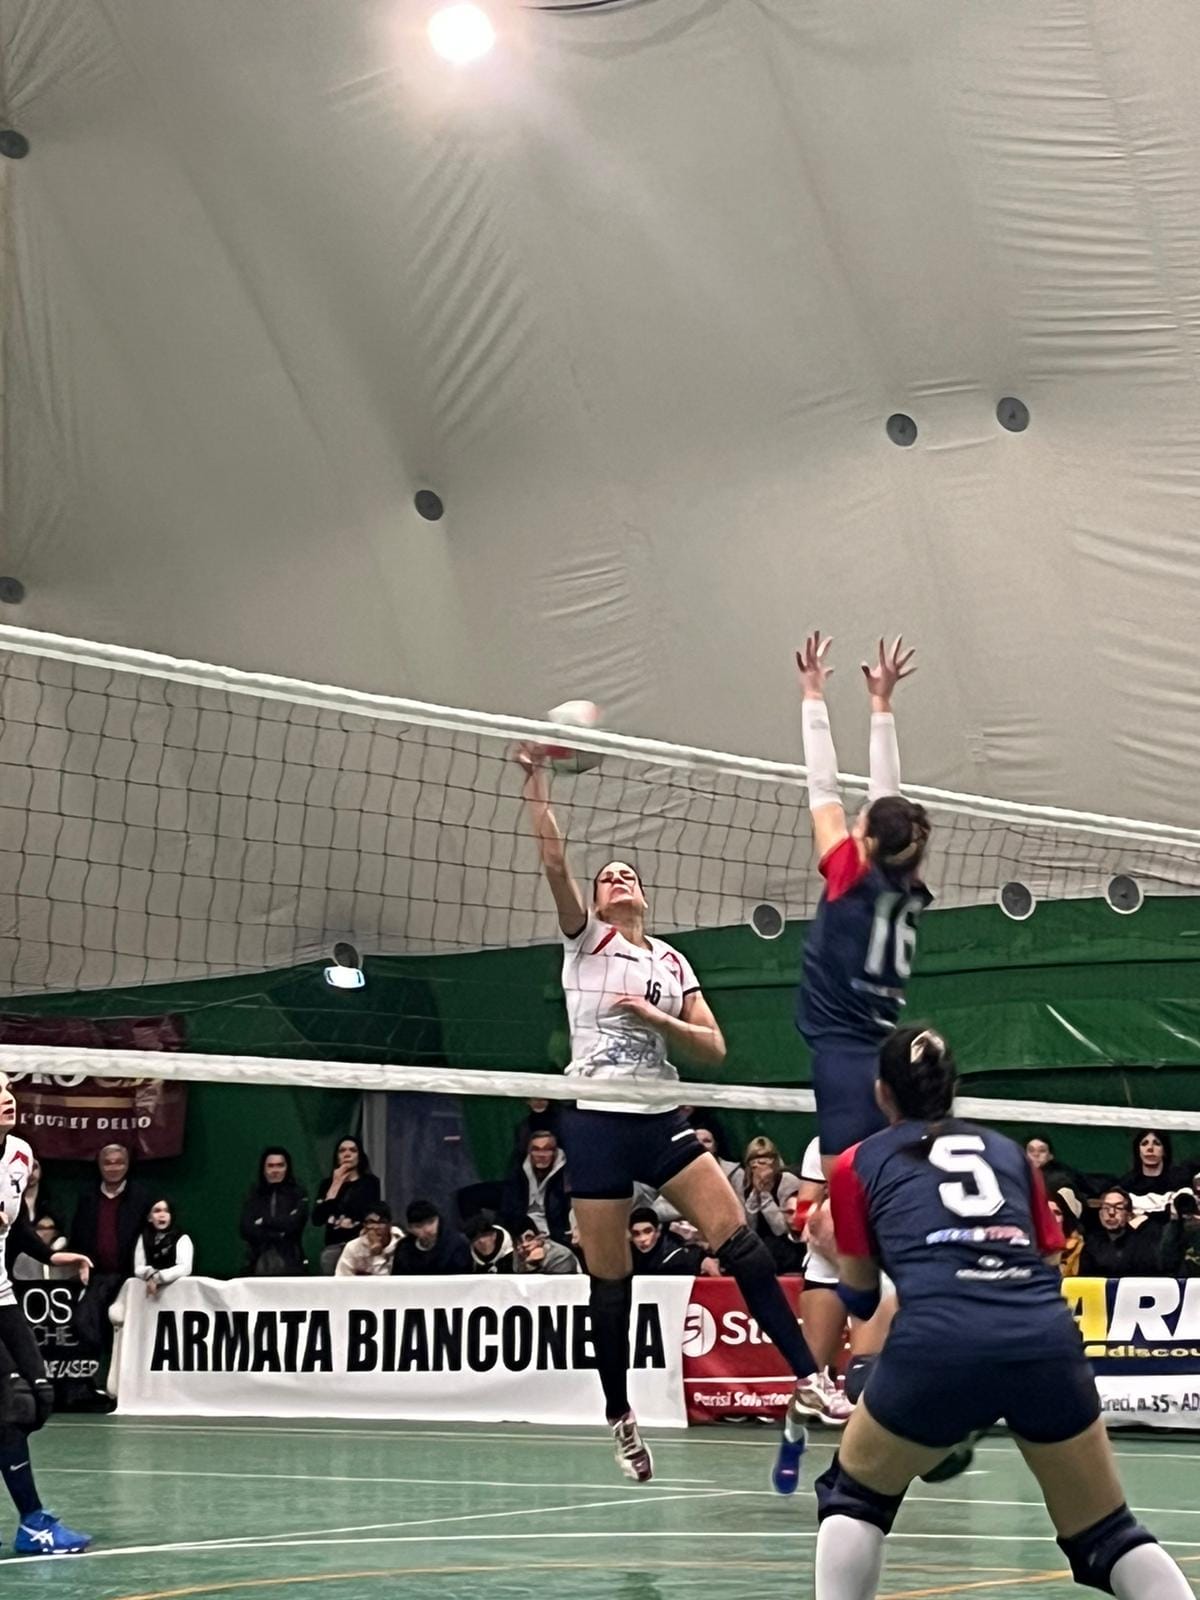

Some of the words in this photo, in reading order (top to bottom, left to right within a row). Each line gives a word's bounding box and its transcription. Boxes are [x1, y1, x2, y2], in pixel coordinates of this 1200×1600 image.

[864, 892, 921, 978] 16
[645, 979, 662, 1006] 16
[928, 1134, 1005, 1217] 5
[23, 1288, 72, 1323] OS
[347, 1303, 666, 1372] BIANCONEA
[150, 1310, 333, 1372] ARMATA
